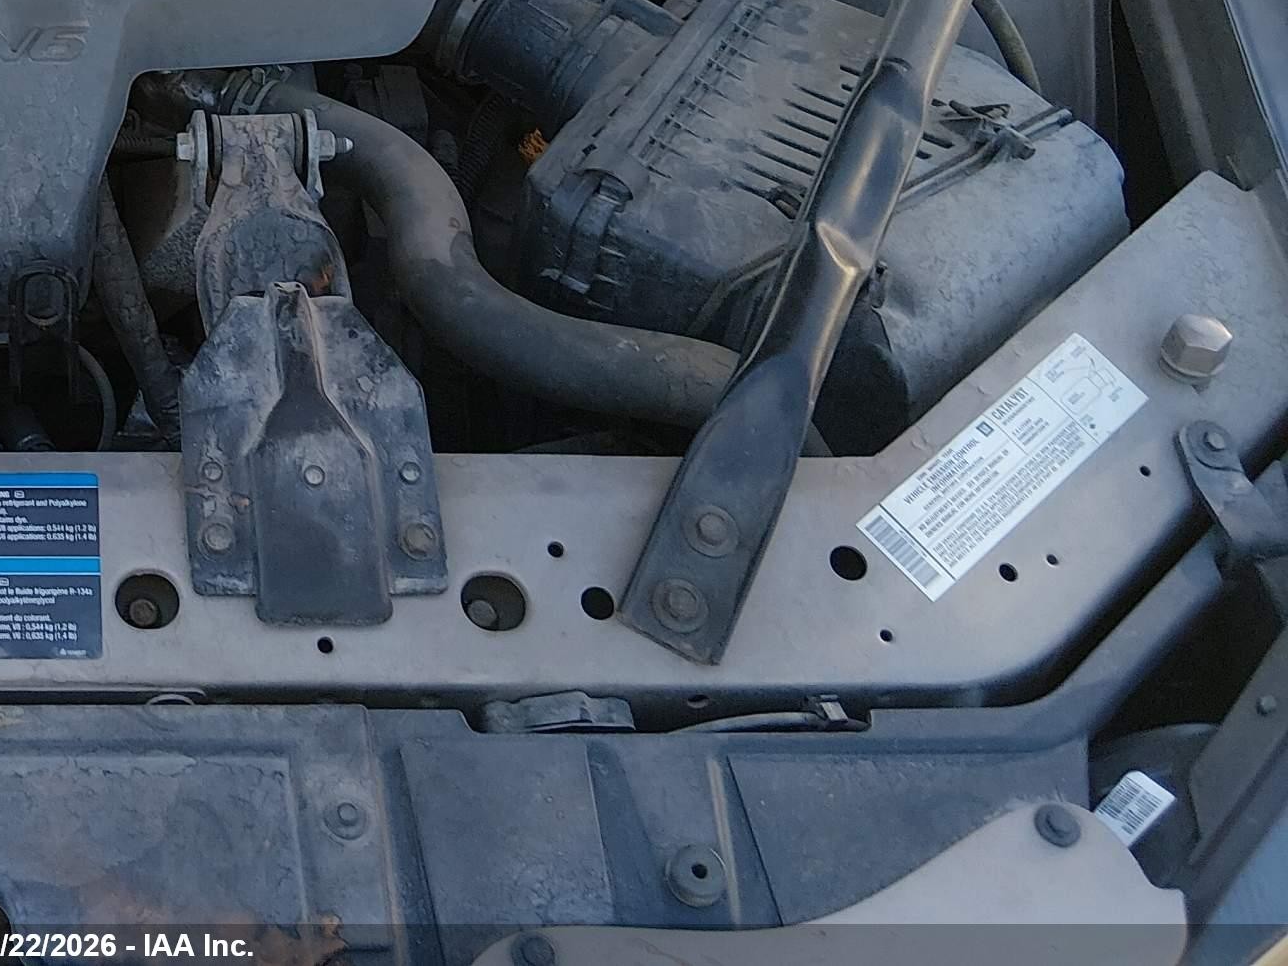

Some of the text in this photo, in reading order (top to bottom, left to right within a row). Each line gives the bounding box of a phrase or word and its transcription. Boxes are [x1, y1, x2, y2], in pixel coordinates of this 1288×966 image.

[990, 386, 1029, 421] CATALYST
[902, 481, 929, 505] VEHICLE
[925, 457, 955, 484] EMISSION
[951, 436, 980, 462] CONTROL
[929, 458, 969, 494] INFORMATION
